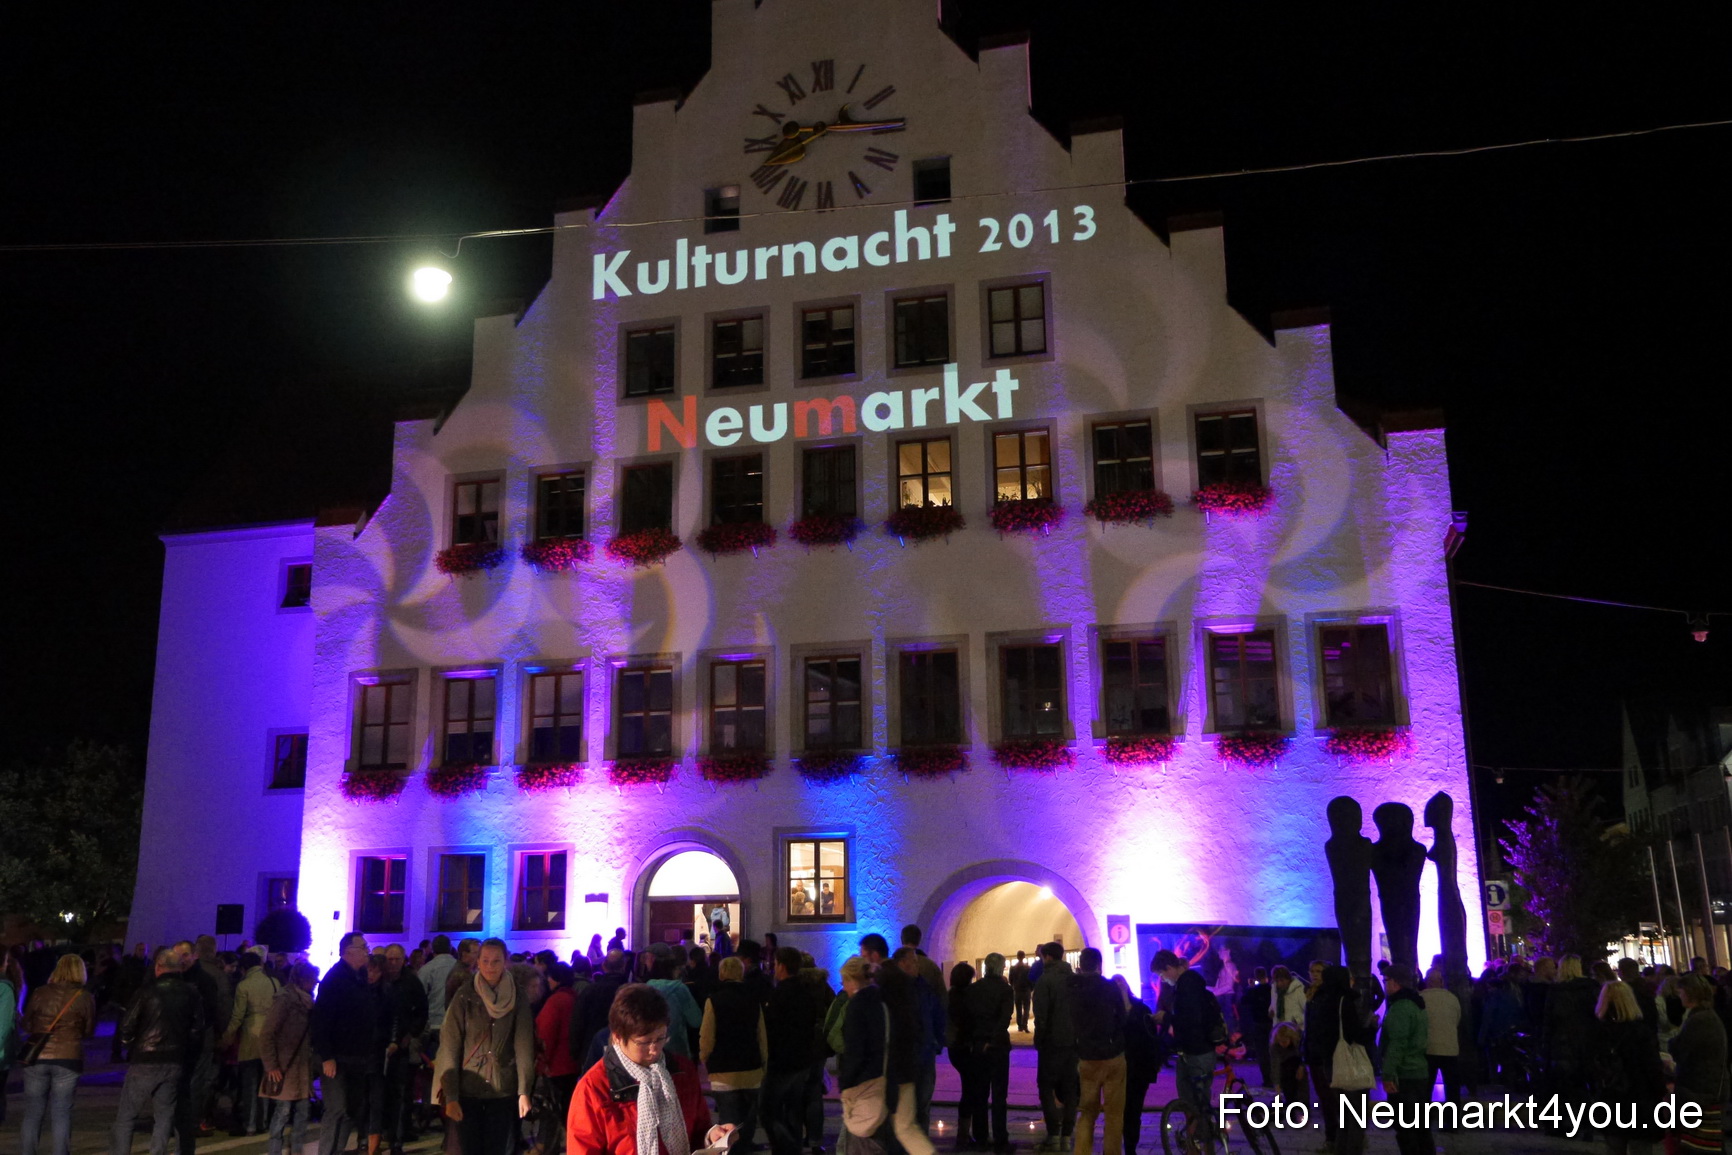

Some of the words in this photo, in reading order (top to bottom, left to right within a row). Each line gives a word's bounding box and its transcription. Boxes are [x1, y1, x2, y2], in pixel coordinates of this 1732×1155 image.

[776, 73, 806, 106] XI
[811, 59, 834, 93] XII
[846, 64, 865, 94] I
[863, 84, 896, 110] II
[752, 104, 786, 125] X
[871, 117, 906, 135] II
[744, 134, 777, 153] IX
[863, 147, 899, 172] IV
[776, 175, 808, 210] VII
[817, 181, 835, 213] VI
[848, 171, 872, 199] V
[592, 209, 956, 300] Kulturnacht
[978, 205, 1097, 253] 2013
[647, 362, 1019, 452] Neumarkt
